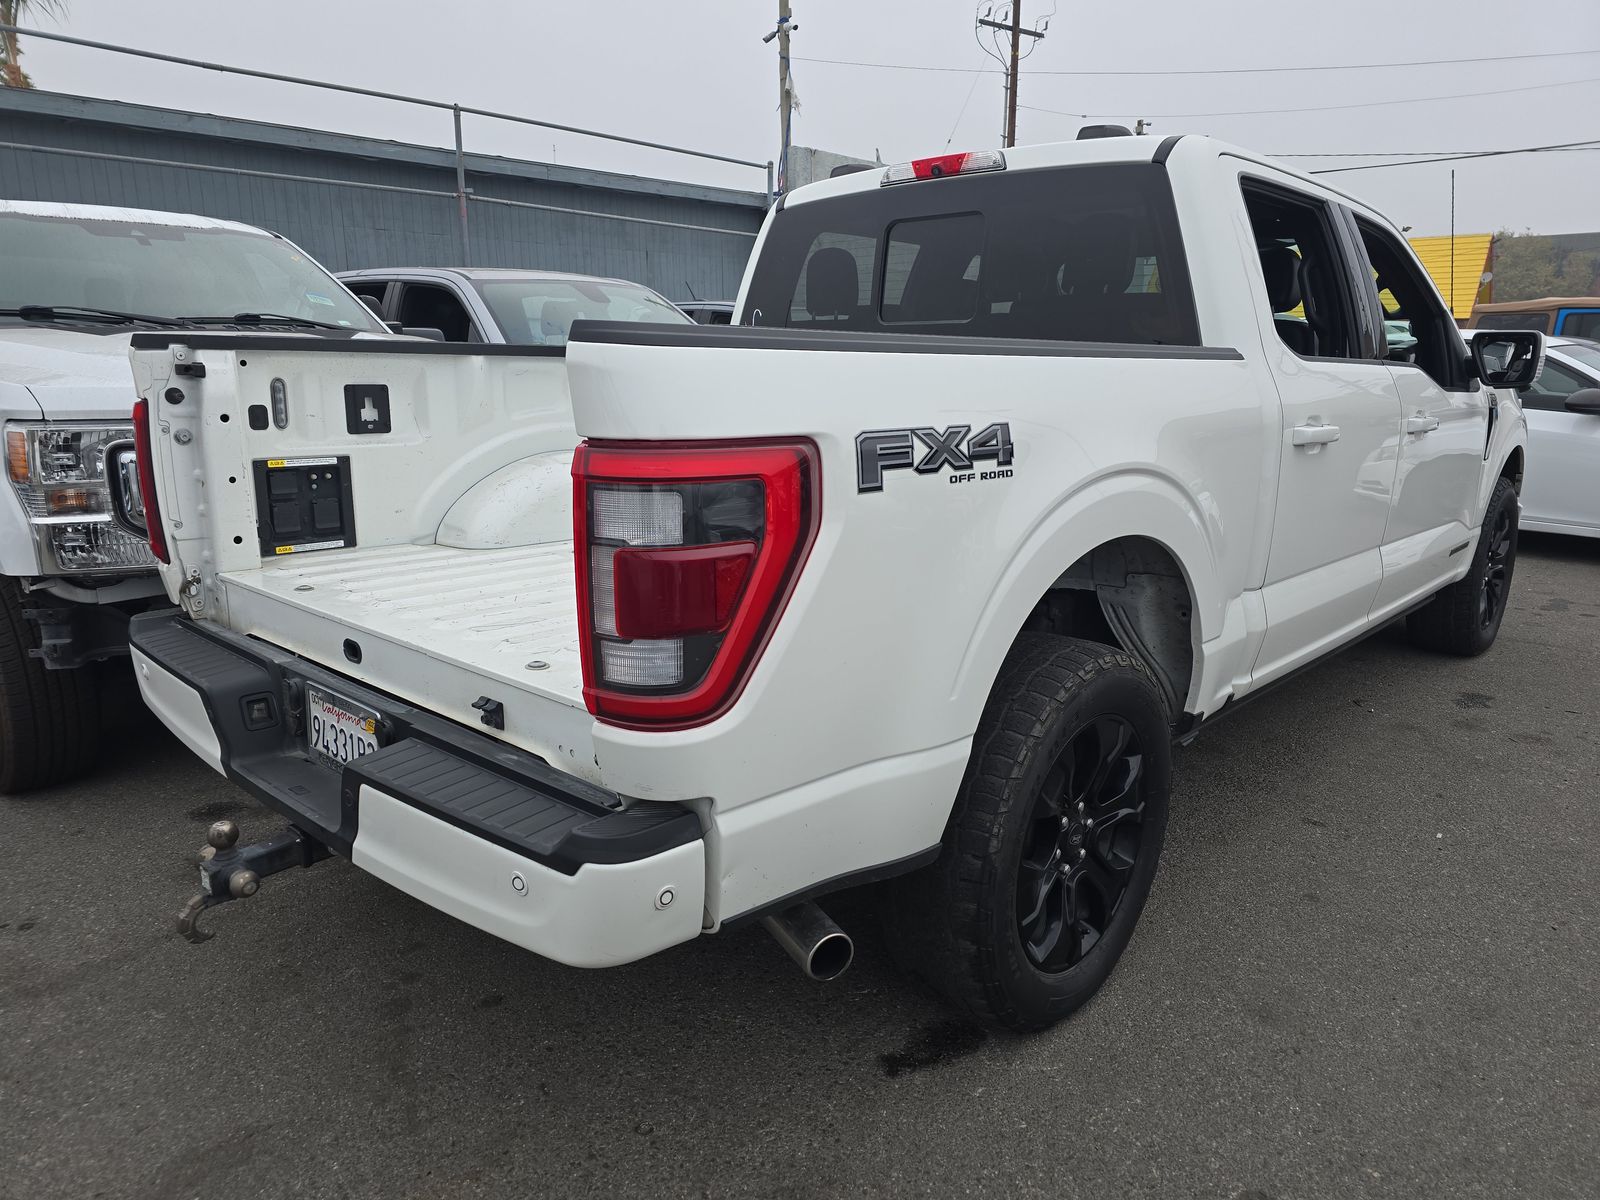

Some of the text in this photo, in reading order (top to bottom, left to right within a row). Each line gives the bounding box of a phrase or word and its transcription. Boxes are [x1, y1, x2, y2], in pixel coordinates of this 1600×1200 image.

[855, 423, 1014, 494] FX4
[949, 469, 1014, 484] OFF ROAD
